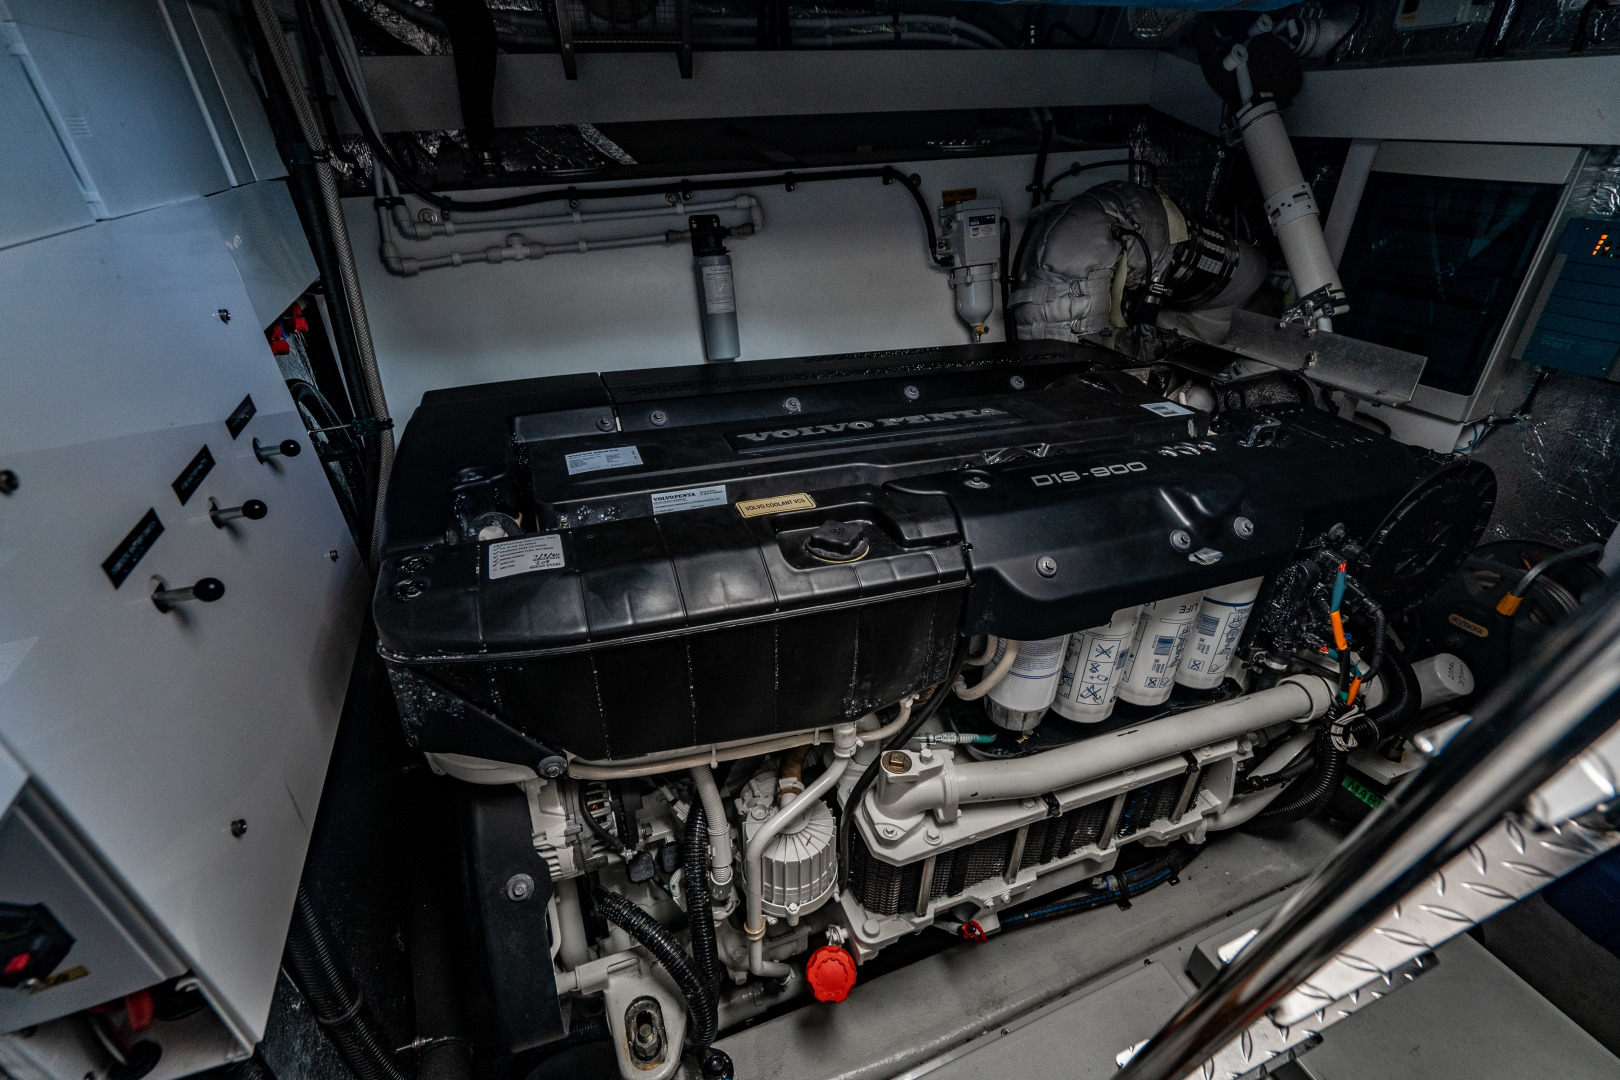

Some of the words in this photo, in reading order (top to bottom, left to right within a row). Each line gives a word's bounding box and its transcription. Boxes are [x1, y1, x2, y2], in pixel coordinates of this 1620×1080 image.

[737, 421, 874, 442] VOLVO
[876, 407, 1009, 428] PENTA
[1030, 461, 1148, 487] D13-900
[745, 503, 765, 511] VOLVO
[765, 499, 793, 508] COOLANT
[1179, 603, 1198, 614] LIFE
